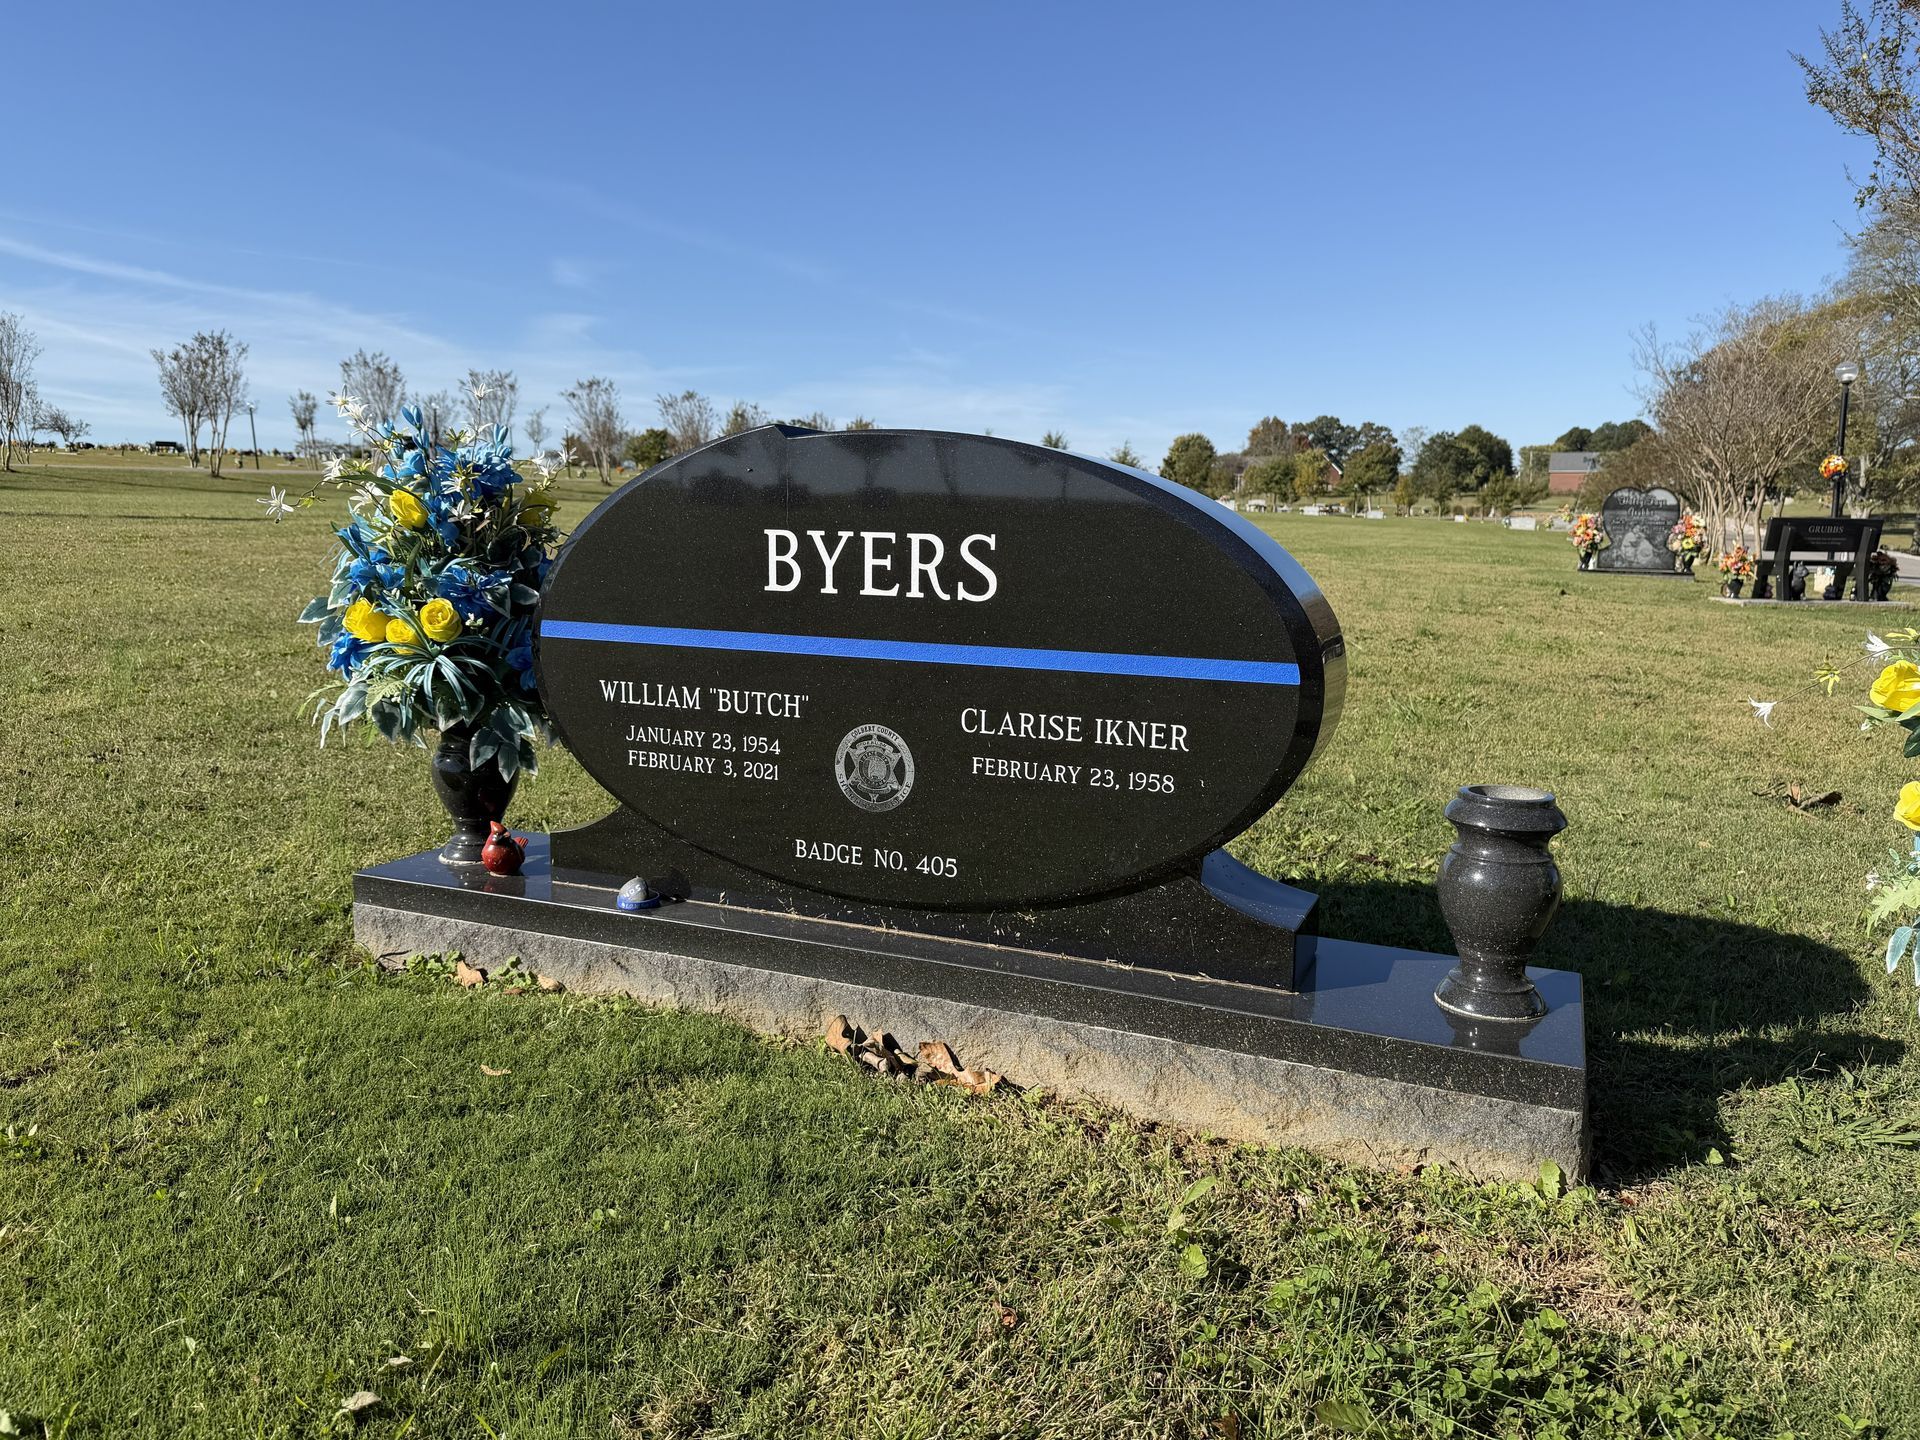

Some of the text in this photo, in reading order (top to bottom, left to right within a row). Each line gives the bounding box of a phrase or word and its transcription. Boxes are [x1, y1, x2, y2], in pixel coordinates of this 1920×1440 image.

[1808, 525, 1845, 534] GRUBBS
[763, 528, 999, 603] BYERS
[598, 679, 810, 719] WILLIAM "BUTCH"
[625, 724, 781, 756] JANUARY 23, 1954
[850, 726, 901, 742] COLBERT COUNTY
[961, 707, 1190, 752] CLARISE IKNER
[628, 749, 779, 781] FEBRUARY 3, 2021
[971, 756, 1175, 795] FEBRUARY 23, 1958
[795, 838, 958, 878] BADGE NO. 405
